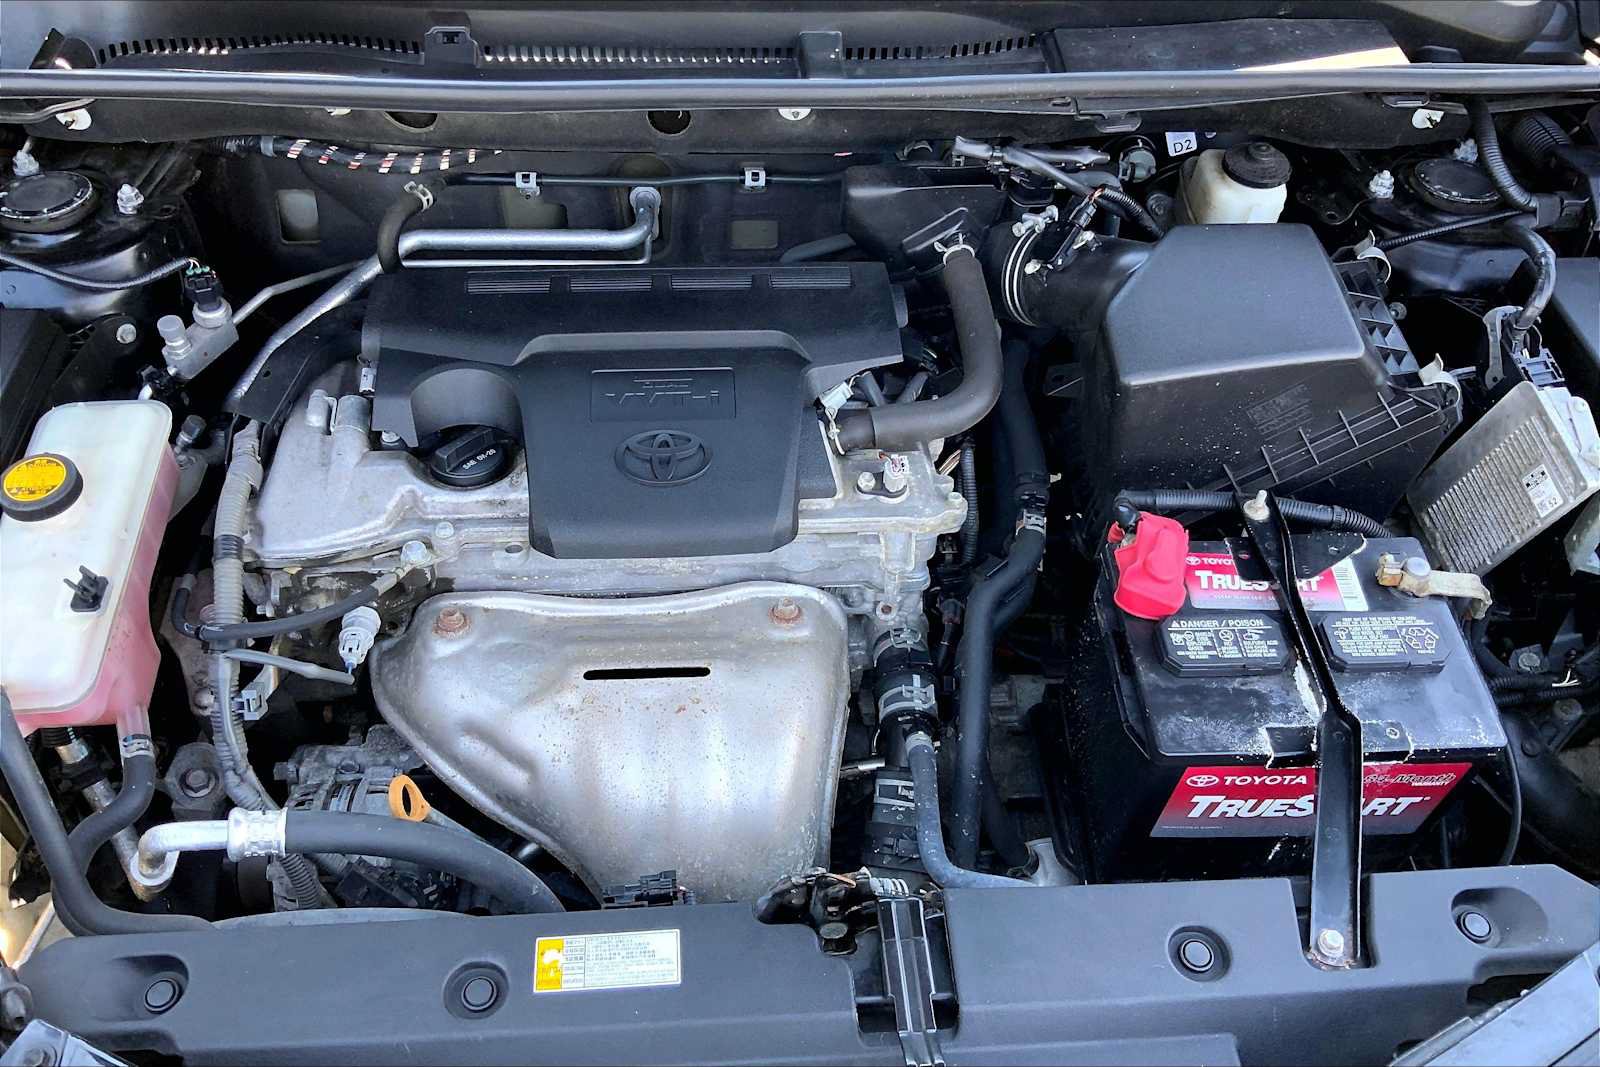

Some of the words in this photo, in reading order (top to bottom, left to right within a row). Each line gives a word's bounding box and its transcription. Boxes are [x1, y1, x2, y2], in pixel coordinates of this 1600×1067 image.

[1173, 139, 1193, 154] D2
[1203, 557, 1235, 566] TOYO
[1180, 620, 1219, 628] DANGER
[1228, 619, 1264, 627] POISON
[1224, 775, 1308, 785] TOYOTA
[1187, 794, 1424, 818] TRUESRT
